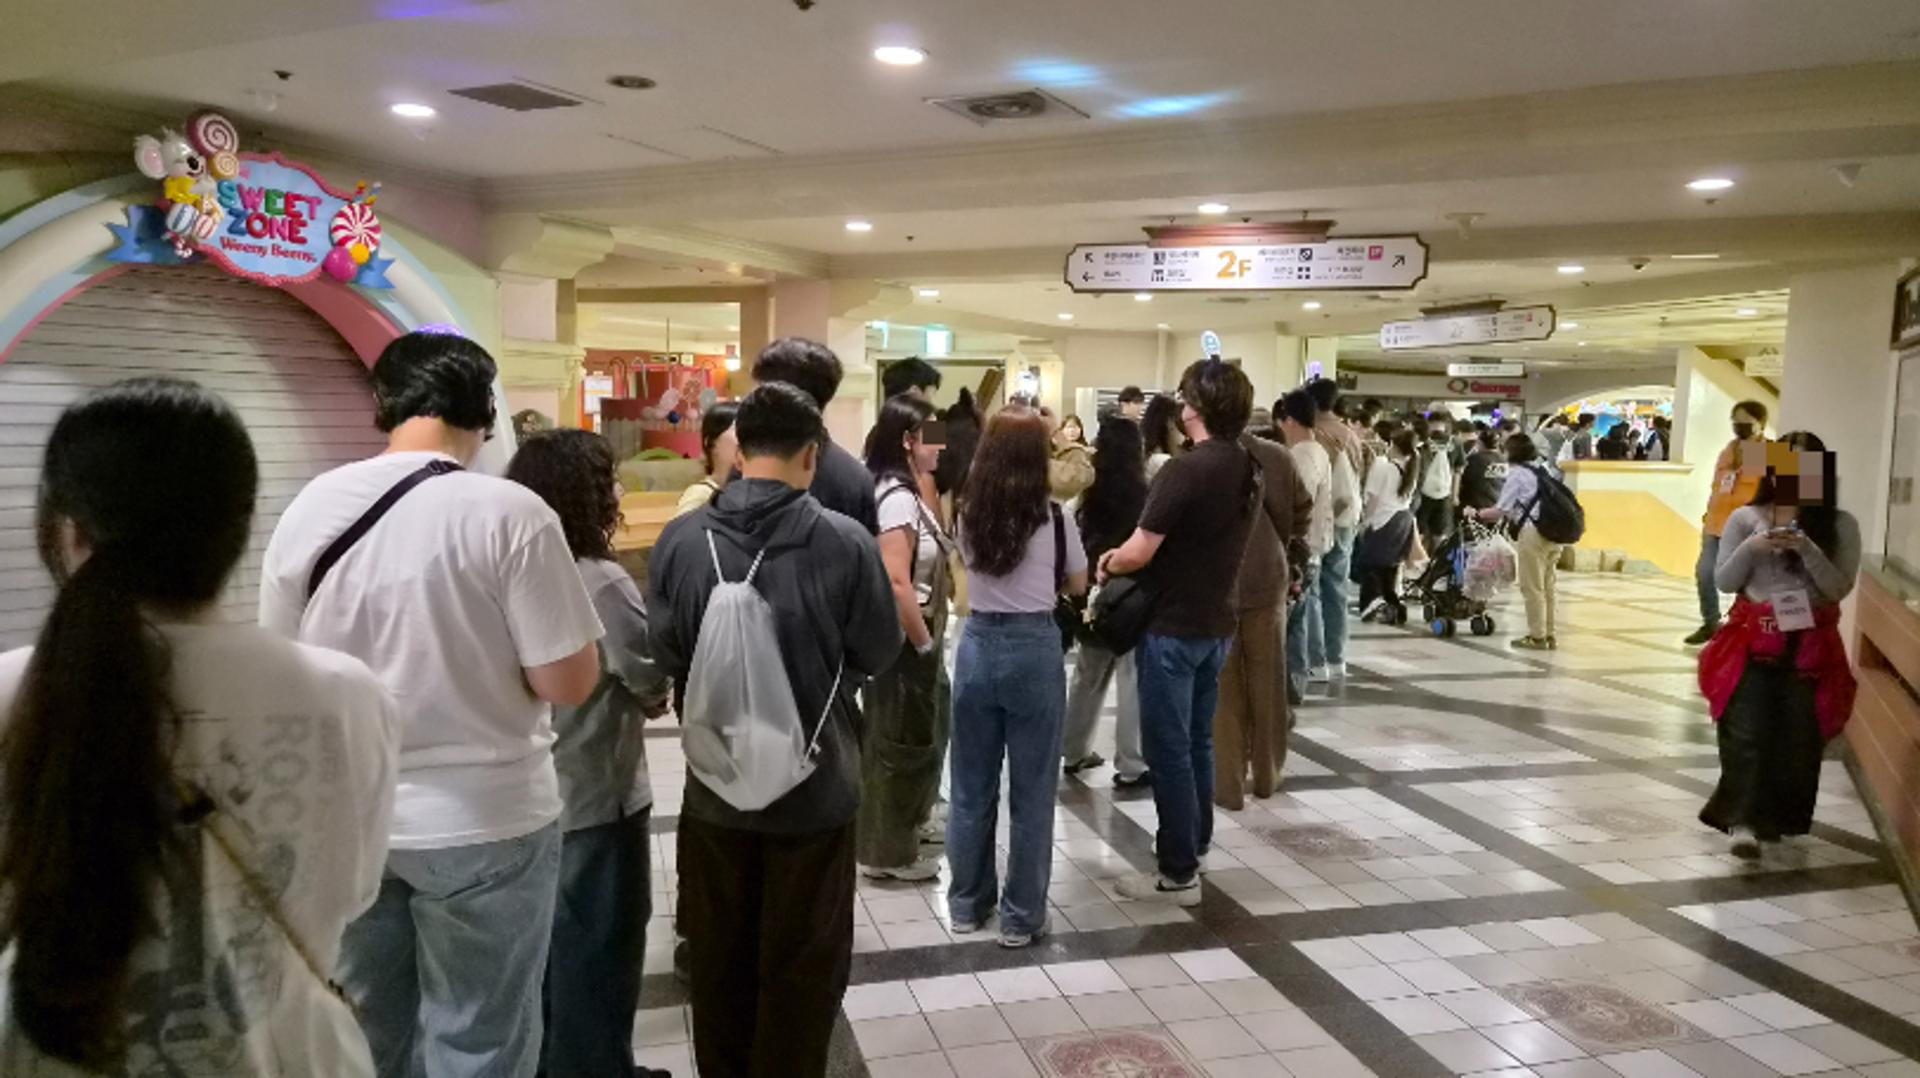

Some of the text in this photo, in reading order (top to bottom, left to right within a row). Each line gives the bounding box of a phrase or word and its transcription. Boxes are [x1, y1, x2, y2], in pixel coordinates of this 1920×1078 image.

[218, 179, 322, 221] SWEET
[227, 207, 308, 244] ZONE
[1216, 250, 1252, 279] 2F
